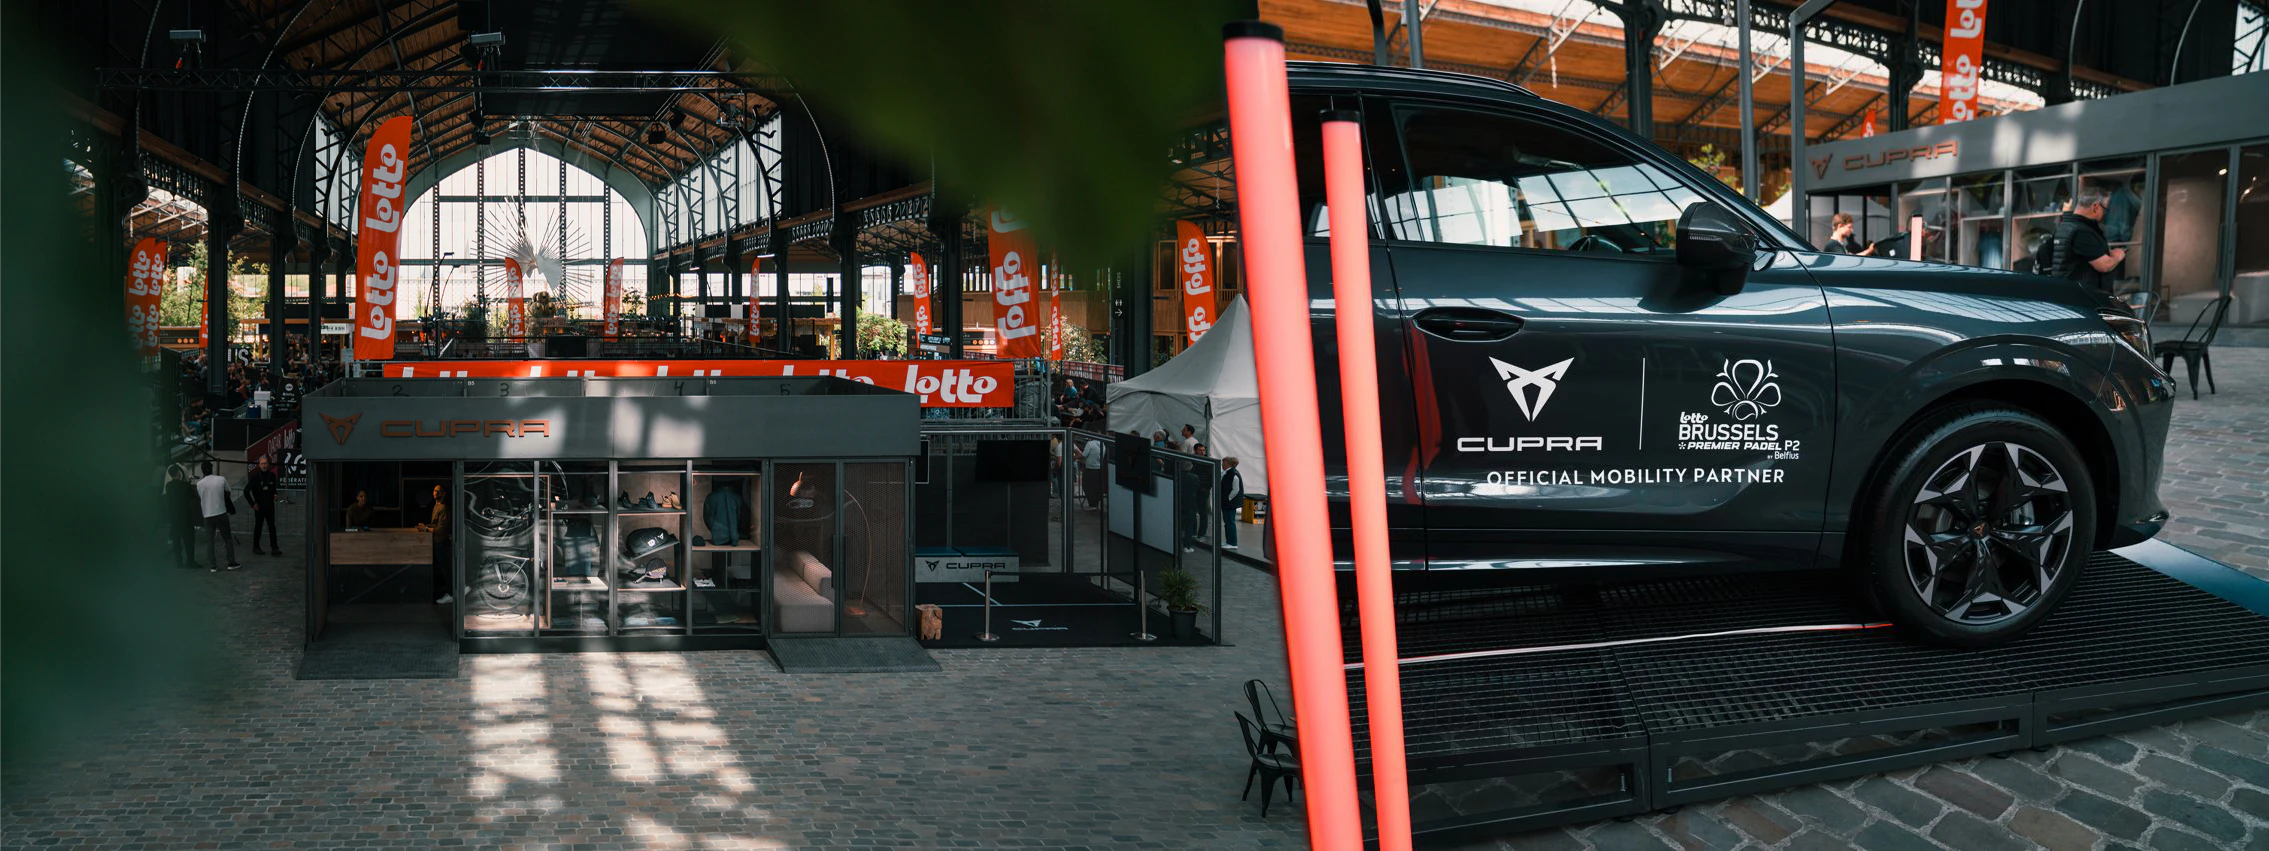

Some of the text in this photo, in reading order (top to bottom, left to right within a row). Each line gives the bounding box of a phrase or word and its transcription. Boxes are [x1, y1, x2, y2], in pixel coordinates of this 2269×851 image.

[1843, 140, 1958, 170] CUPRA
[366, 143, 404, 233] lotto
[128, 250, 151, 296] lotto
[149, 253, 163, 296] lotto
[1182, 238, 1211, 296] lotto
[361, 250, 396, 341] lotto
[994, 251, 1036, 340] lotto
[144, 304, 159, 347] lotto
[904, 364, 998, 404] lotto
[381, 419, 549, 437] CUPRA
[1457, 436, 1603, 452] CUPRA
[1678, 424, 1779, 441] BRUSSELS
[1687, 440, 1800, 451] PREMIER PADEL P2
[1774, 451, 1799, 460] Belfius
[1487, 468, 1785, 486] OFFICIAL MOBILITY PARTNER
